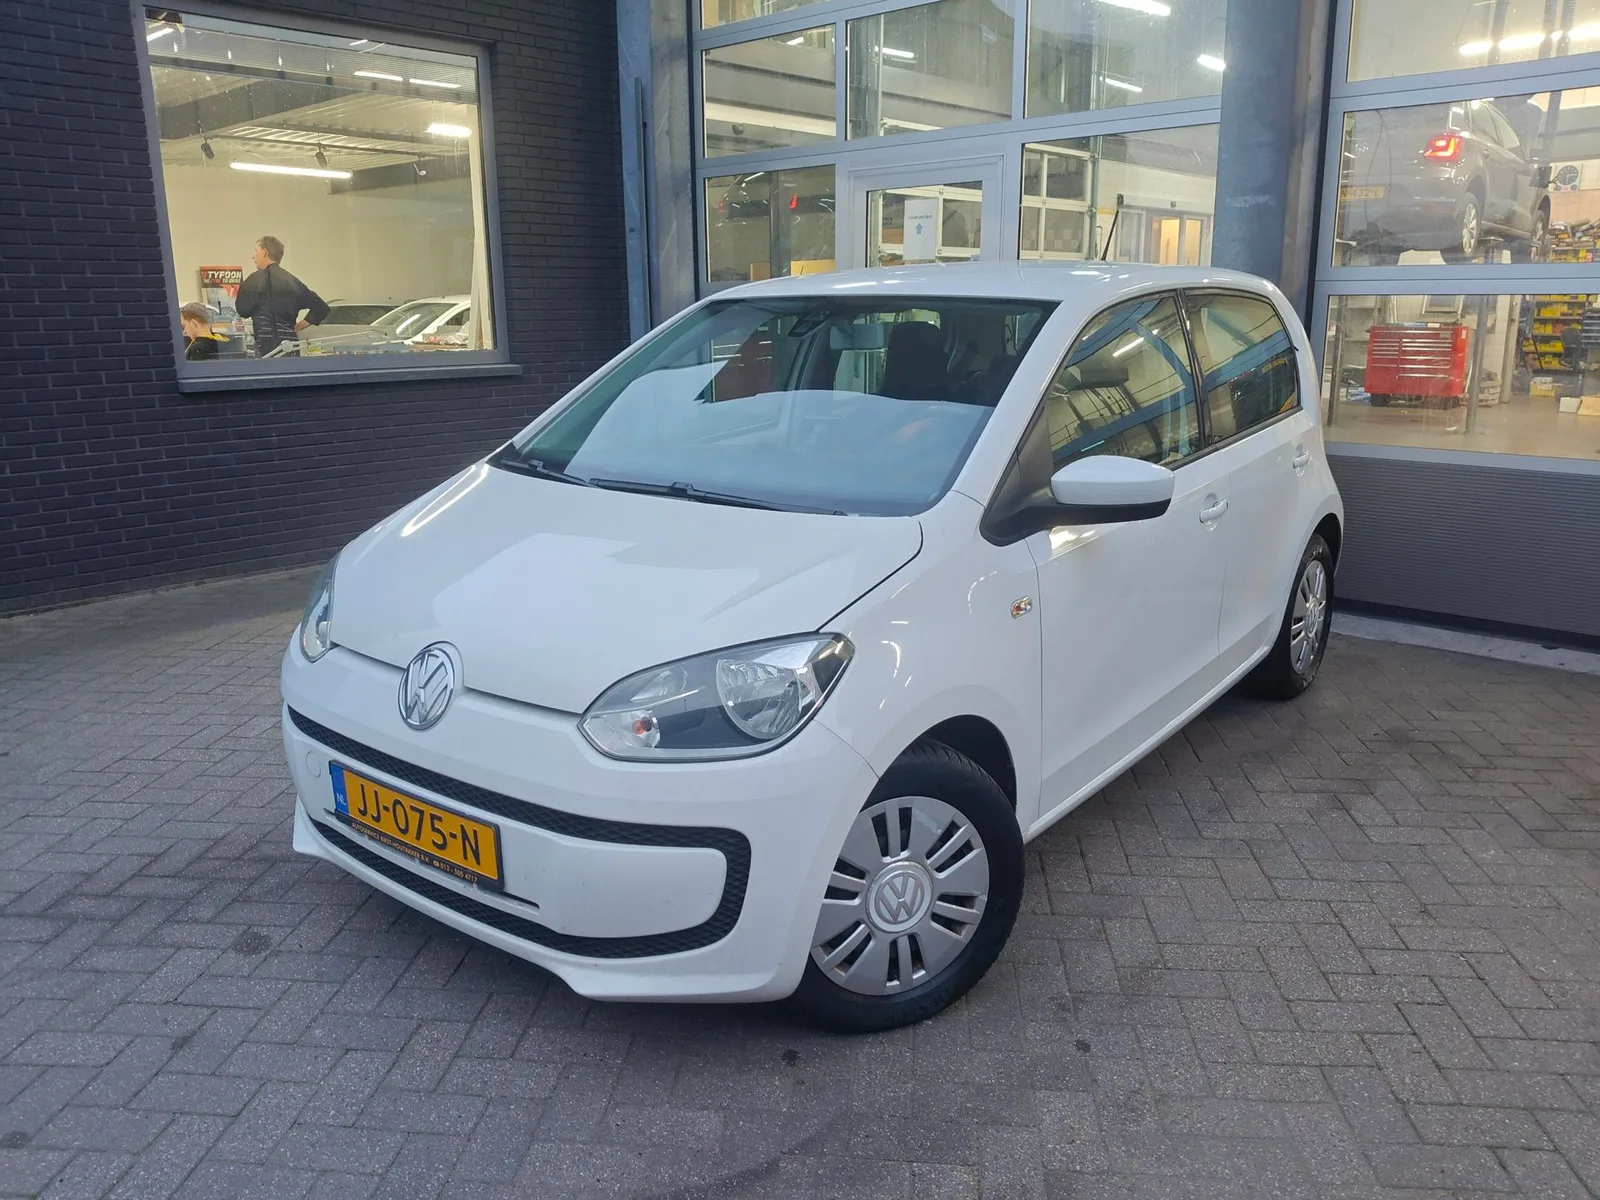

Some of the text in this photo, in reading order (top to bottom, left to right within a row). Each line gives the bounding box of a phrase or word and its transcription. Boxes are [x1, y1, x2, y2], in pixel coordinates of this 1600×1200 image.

[336, 793, 347, 806] NL
[351, 822, 380, 840] AUTOSERVICE
[357, 783, 481, 867] JJ-075-N
